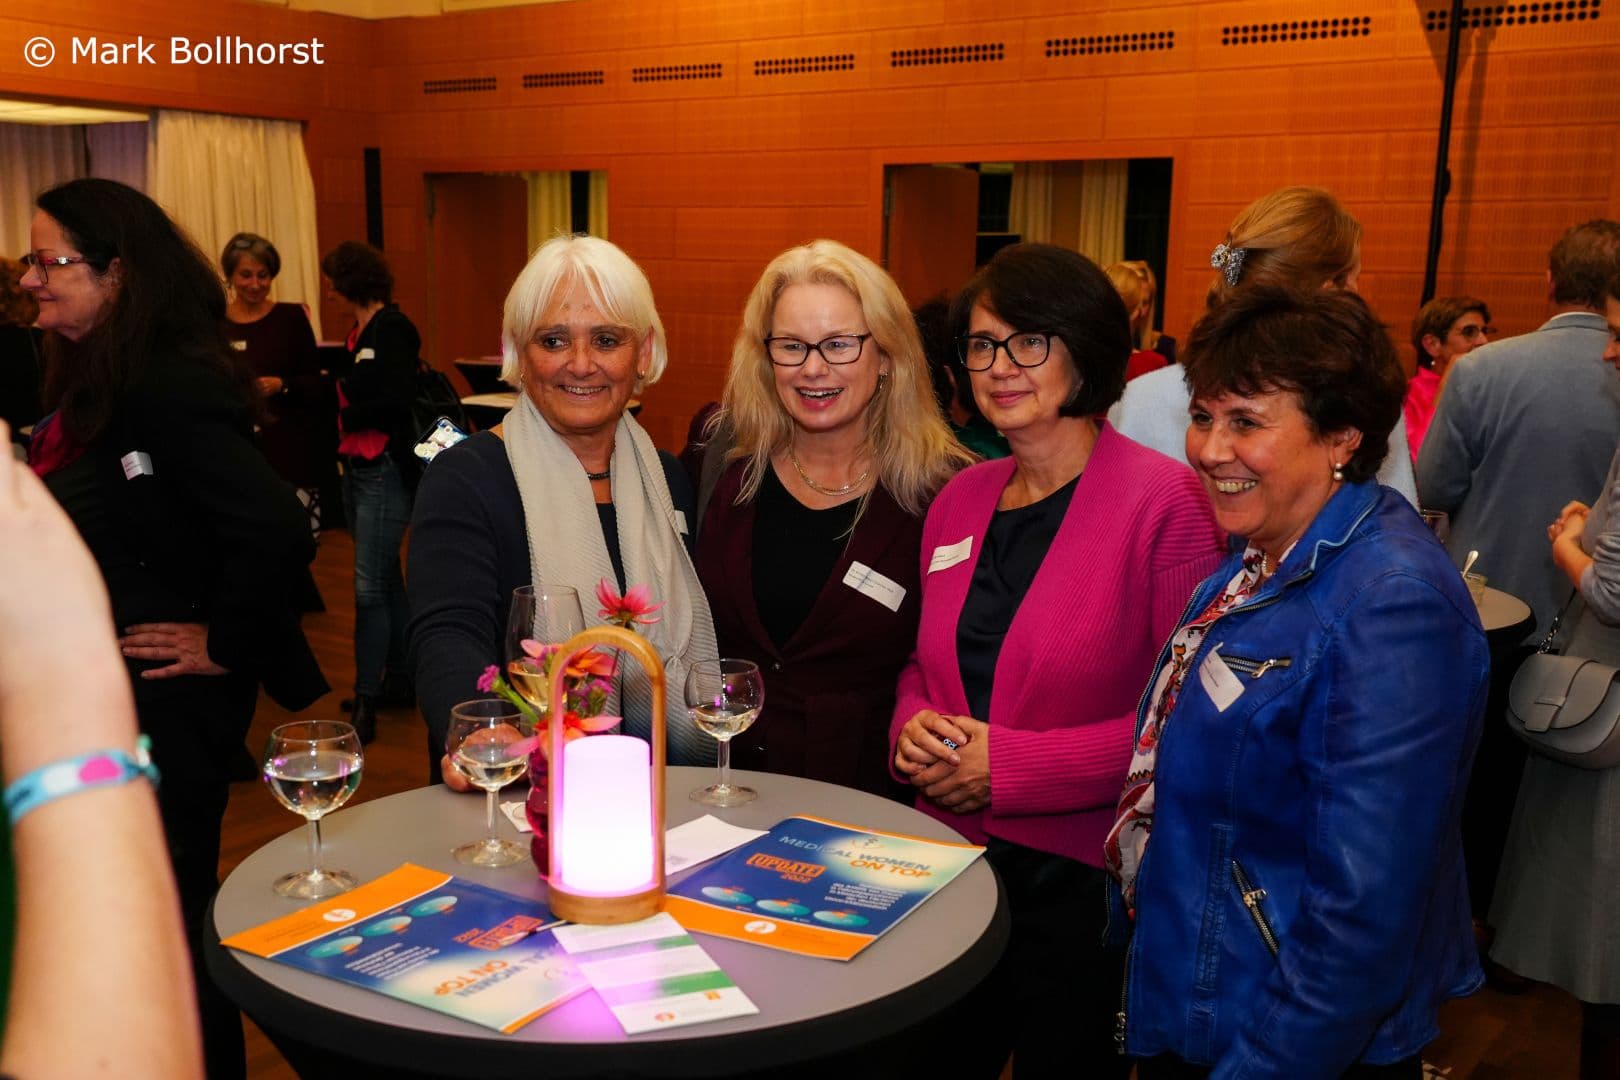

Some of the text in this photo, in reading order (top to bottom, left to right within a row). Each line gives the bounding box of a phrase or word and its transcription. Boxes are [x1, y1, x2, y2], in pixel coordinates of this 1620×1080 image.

[779, 836, 931, 871] MEDICAL WOMEN
[850, 859, 932, 878] ON TOP
